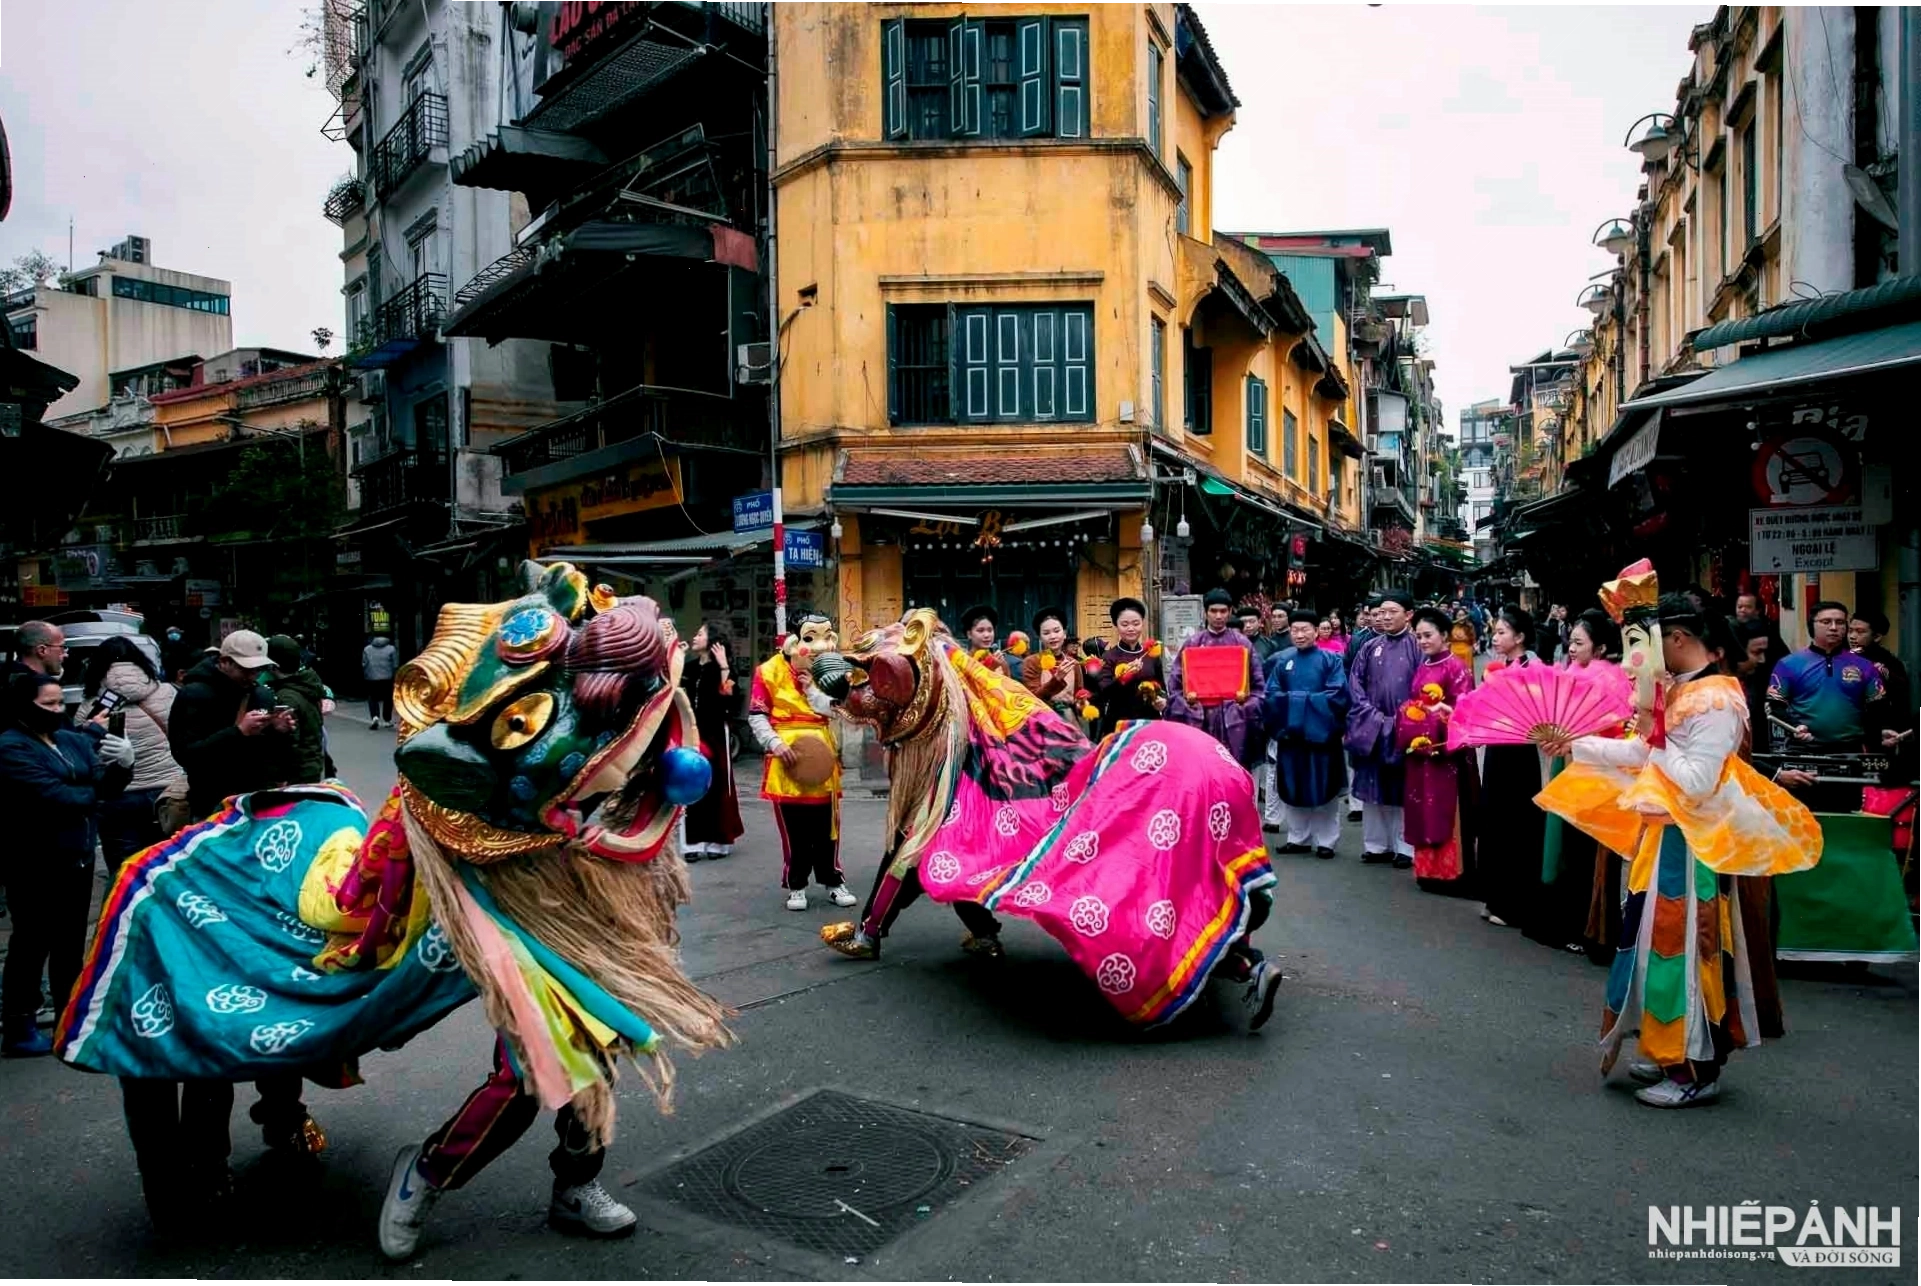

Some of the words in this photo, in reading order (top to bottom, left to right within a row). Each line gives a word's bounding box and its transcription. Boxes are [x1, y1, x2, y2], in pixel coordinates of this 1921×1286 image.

[746, 497, 760, 509] PHỐ
[797, 535, 810, 545] PHỐ
[788, 547, 798, 562] TẠ
